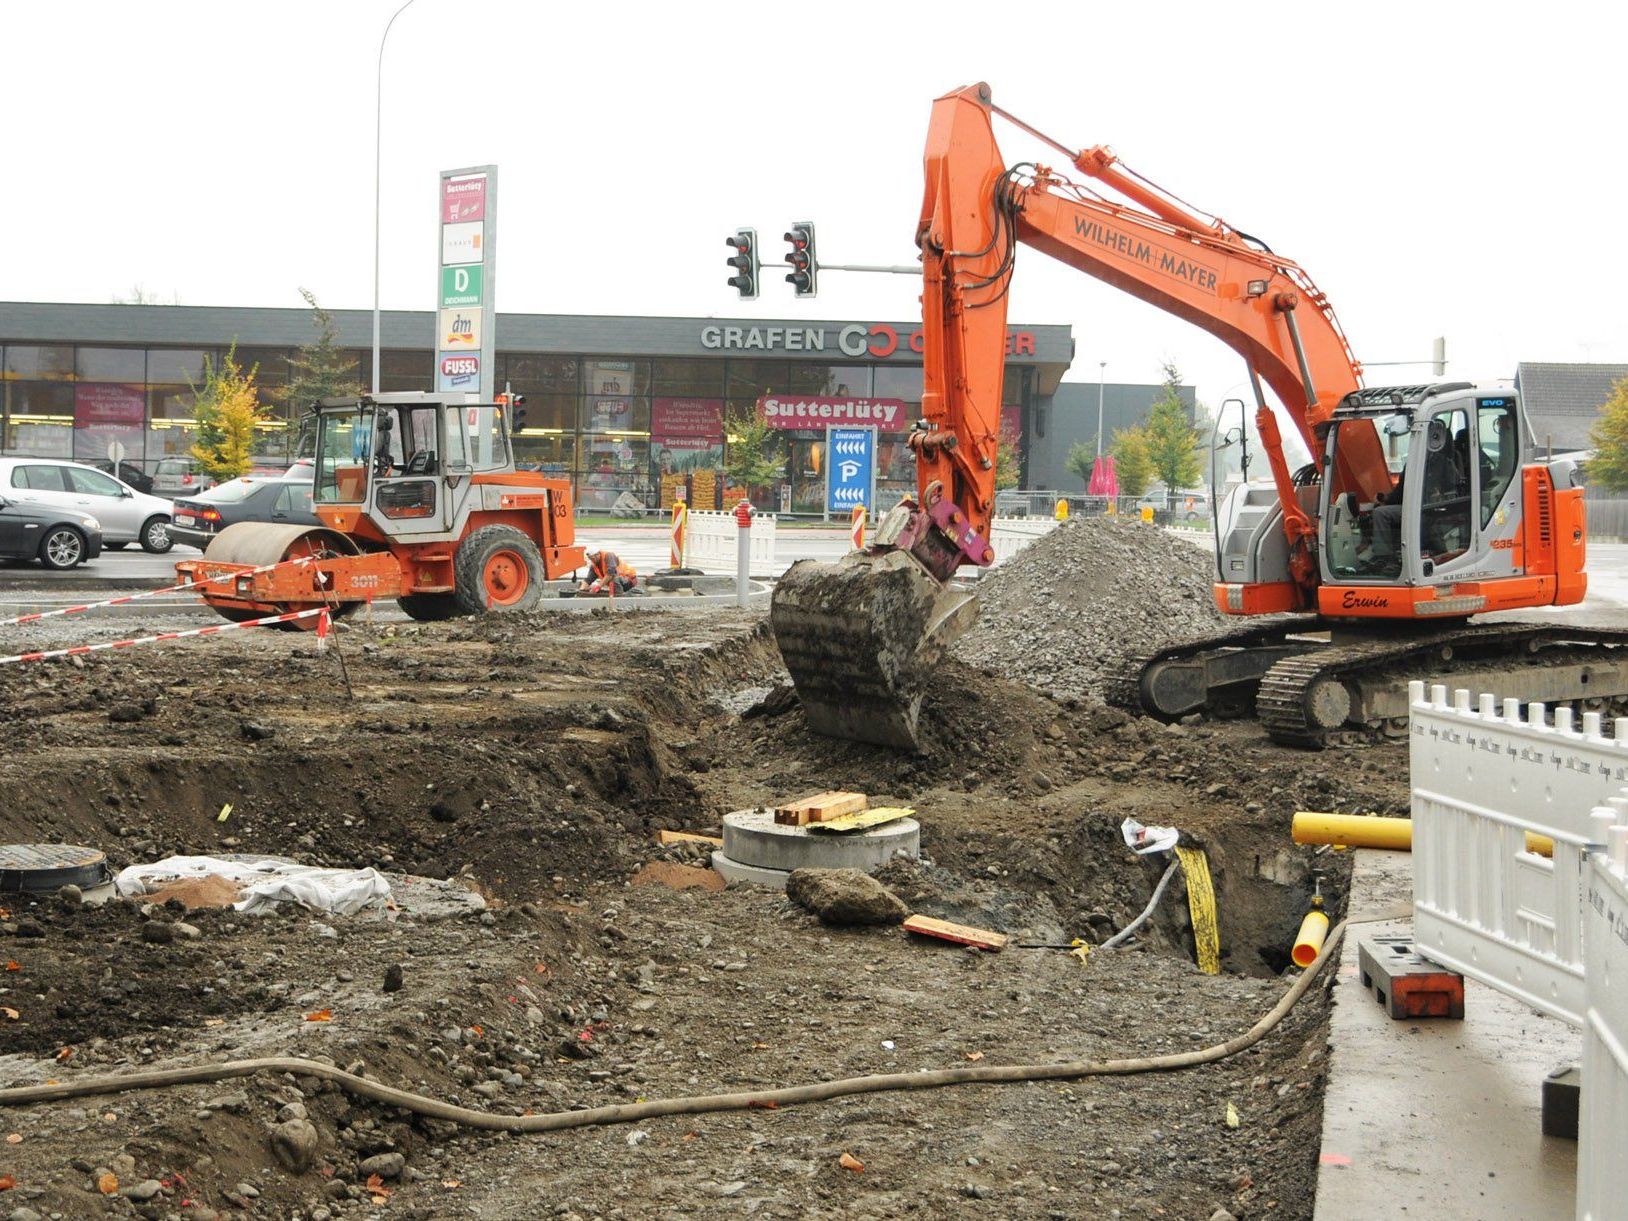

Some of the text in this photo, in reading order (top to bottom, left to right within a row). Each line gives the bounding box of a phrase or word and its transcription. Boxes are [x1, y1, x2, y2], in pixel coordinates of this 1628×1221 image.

[1074, 215, 1217, 291] WILHELM MAYER
[455, 269, 469, 292] D
[452, 313, 471, 333] dm
[701, 326, 824, 350] GRAFEN
[445, 360, 477, 374] FUSSL
[764, 399, 897, 422] Sutterlüty
[841, 465, 858, 482] P
[553, 489, 563, 502] W
[554, 504, 566, 517] 03
[351, 575, 378, 588] 3011
[1342, 590, 1389, 609] Erwin
